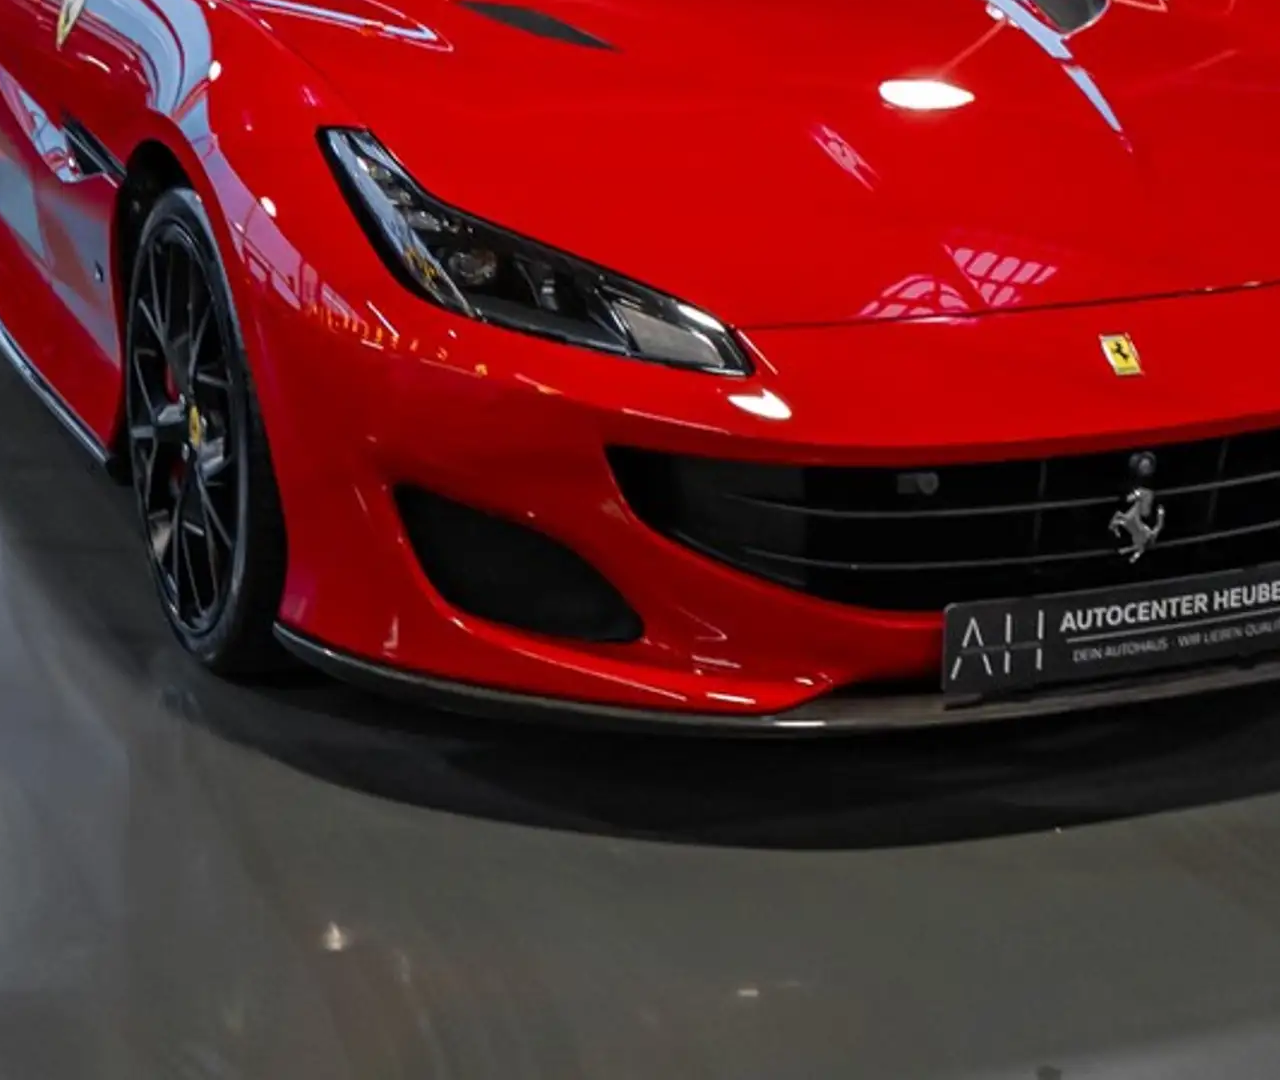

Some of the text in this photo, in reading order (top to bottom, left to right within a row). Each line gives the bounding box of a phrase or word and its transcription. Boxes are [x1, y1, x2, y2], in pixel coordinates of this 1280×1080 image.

[1059, 592, 1209, 633] AUTOCENTER
[950, 609, 1045, 681] AH
[1105, 637, 1169, 658] AUTOHAUS
